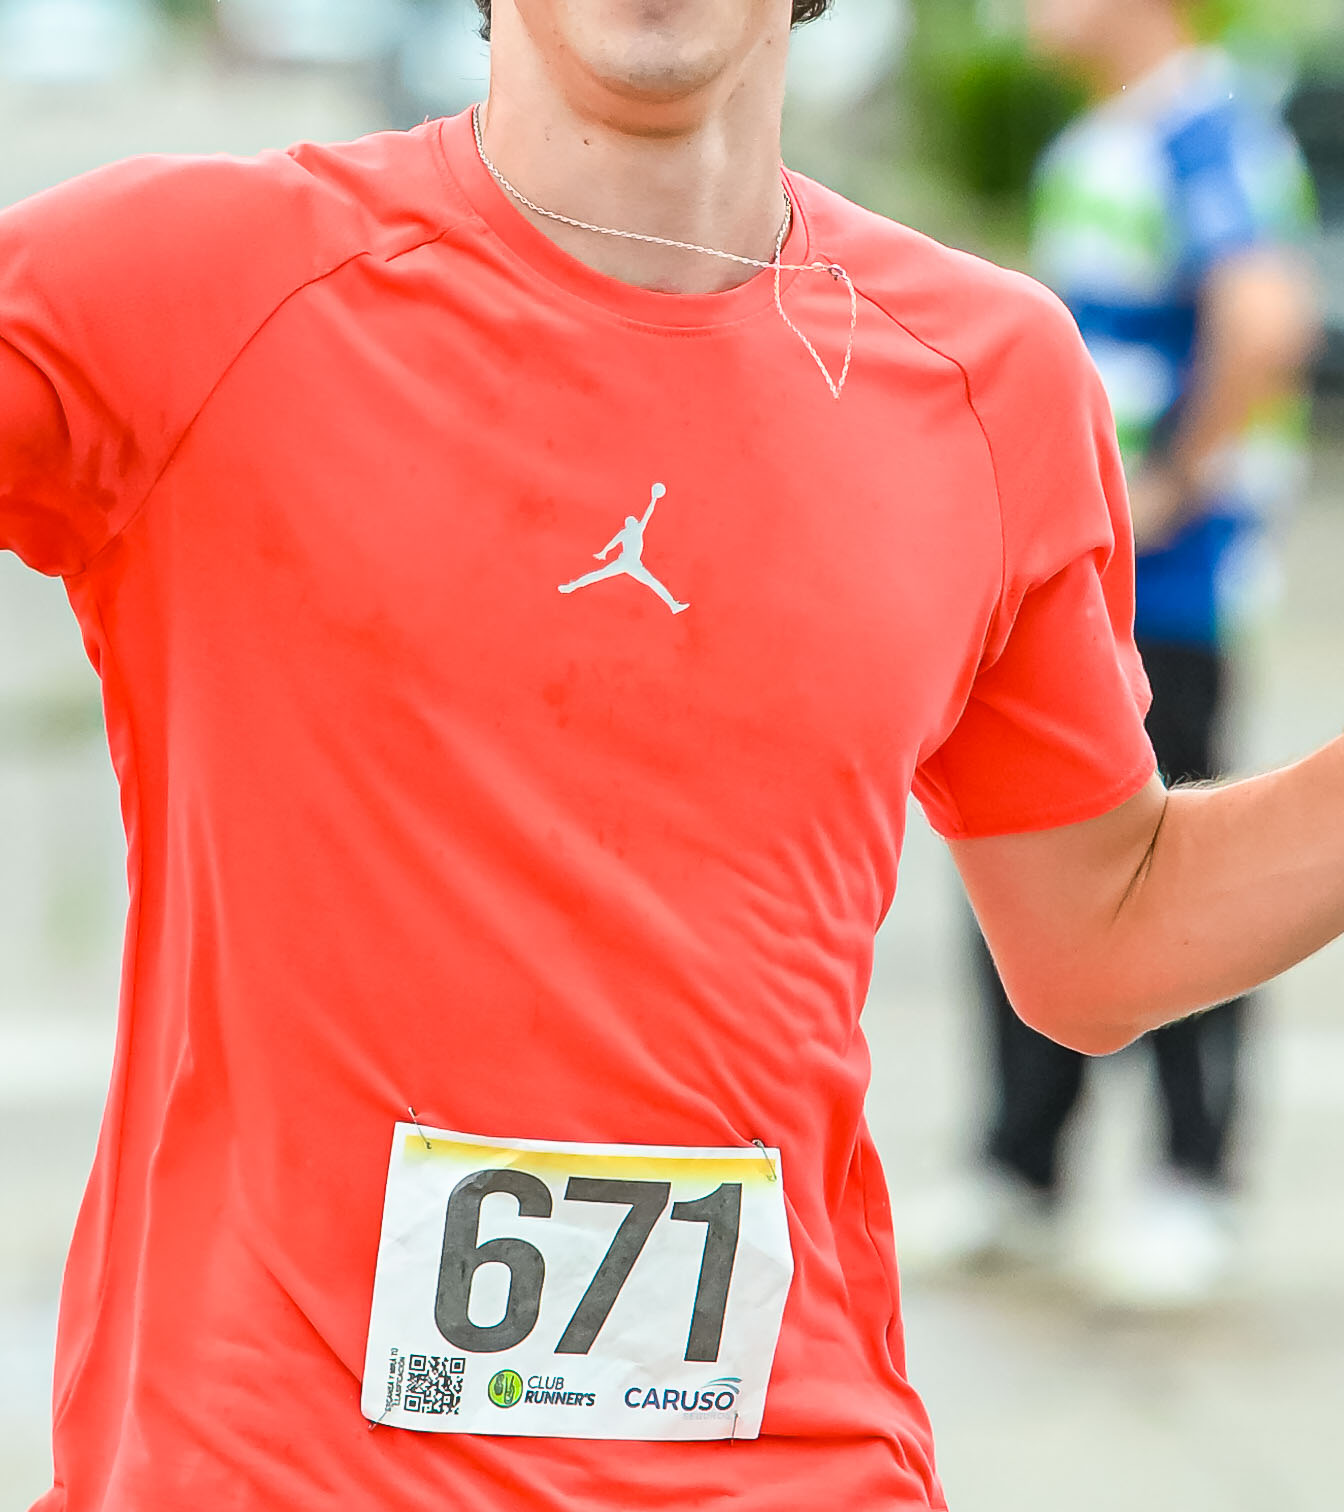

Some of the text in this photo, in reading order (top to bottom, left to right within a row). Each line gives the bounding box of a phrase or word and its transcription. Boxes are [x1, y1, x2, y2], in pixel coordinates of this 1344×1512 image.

[434, 1168, 743, 1363] 671
[528, 1375, 564, 1390] CLUB
[524, 1390, 596, 1406] RUNNER'S
[624, 1387, 735, 1411] CARUSO
